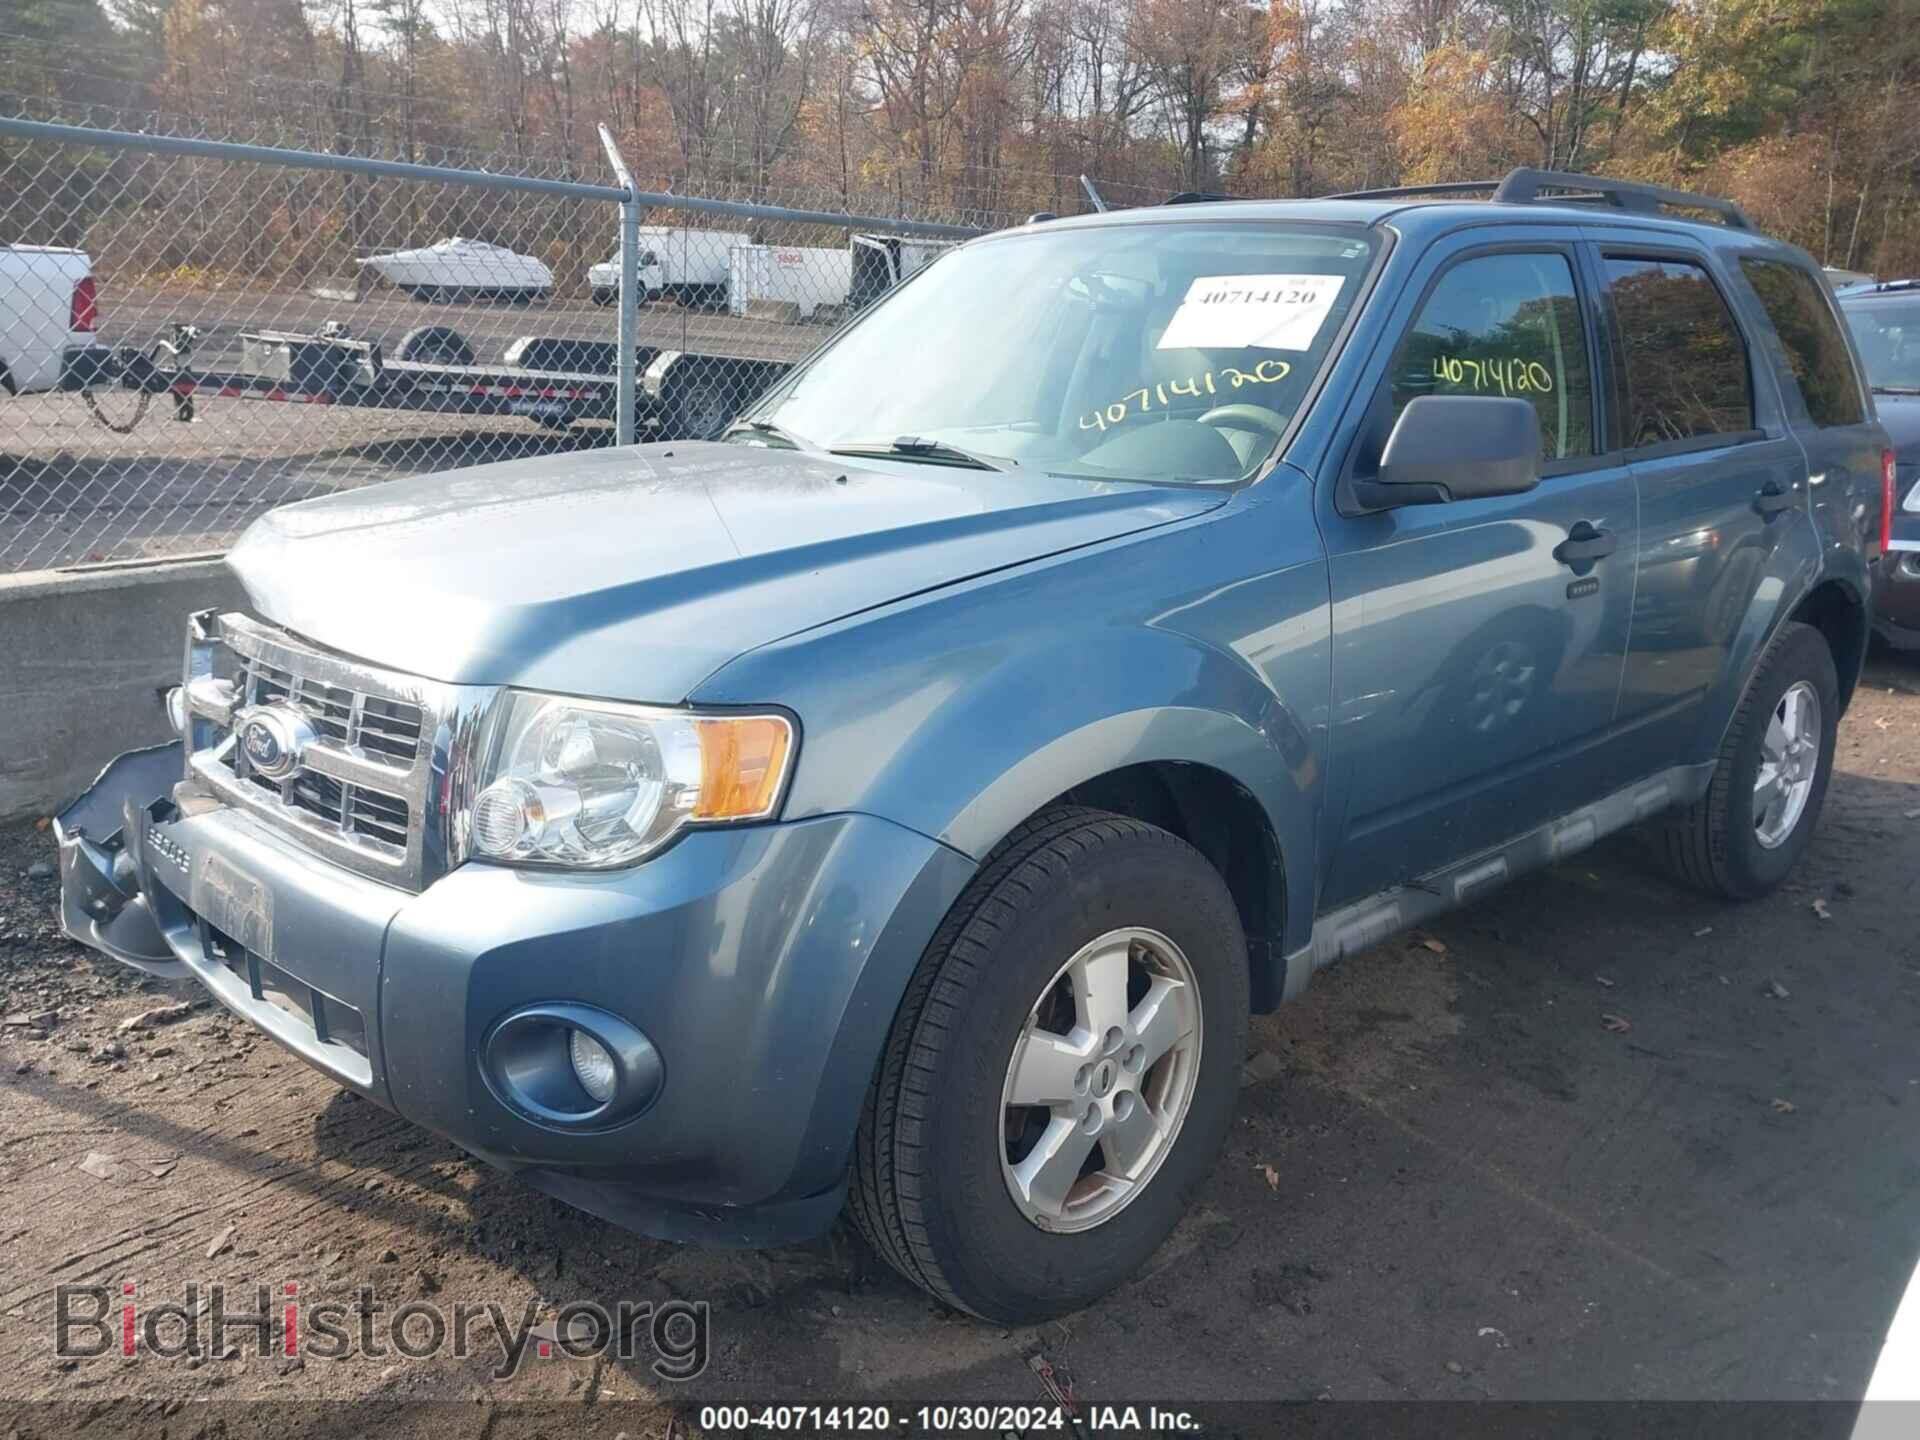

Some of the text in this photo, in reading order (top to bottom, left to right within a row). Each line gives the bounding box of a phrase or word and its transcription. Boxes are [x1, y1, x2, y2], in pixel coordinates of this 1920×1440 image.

[1199, 289, 1318, 305] 40714120
[1079, 359, 1291, 432] 40714120
[1432, 354, 1553, 397] 40714120
